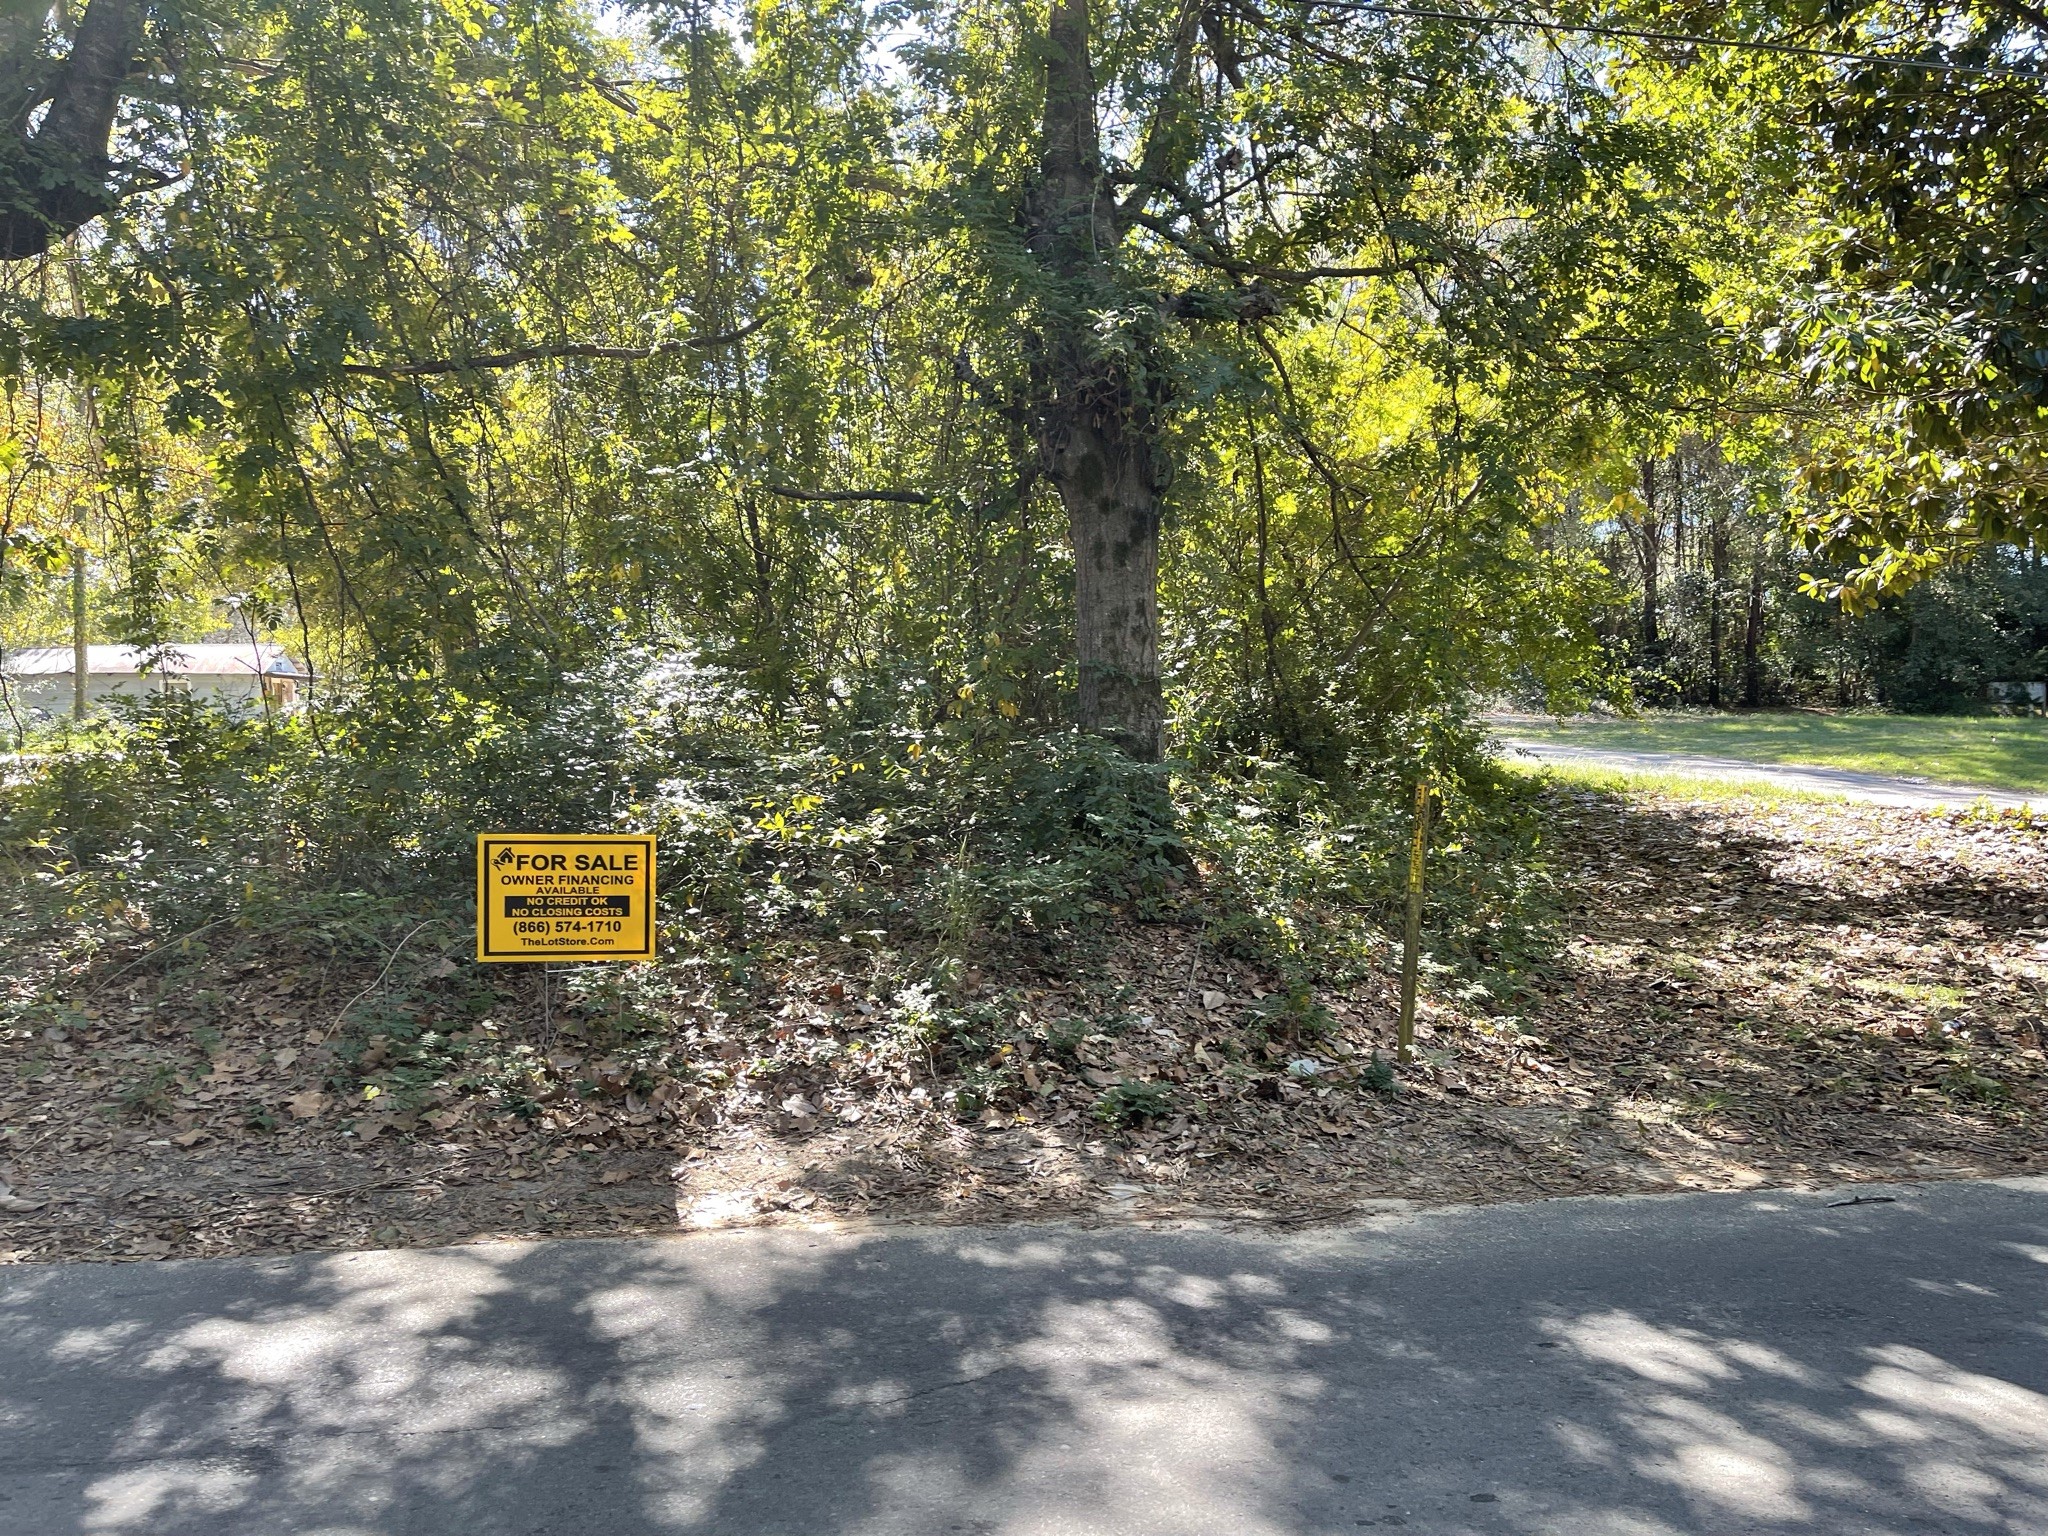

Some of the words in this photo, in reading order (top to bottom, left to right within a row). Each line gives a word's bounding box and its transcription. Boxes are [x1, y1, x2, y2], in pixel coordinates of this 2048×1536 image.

[516, 854, 568, 871] FOR
[575, 854, 638, 871] SALE
[500, 875, 555, 885] OWNER
[558, 875, 634, 885] FINANCING
[535, 886, 600, 895] AVAILABLE
[527, 897, 545, 906] NO
[546, 897, 588, 906] CREDIT
[590, 897, 608, 906] OK
[511, 908, 529, 917] NO
[531, 908, 582, 917] CLOSING
[585, 907, 623, 916] COSTS
[513, 921, 550, 936] (866)
[555, 920, 622, 933] 574-1710
[520, 937, 615, 946] TheLotStore.Com
